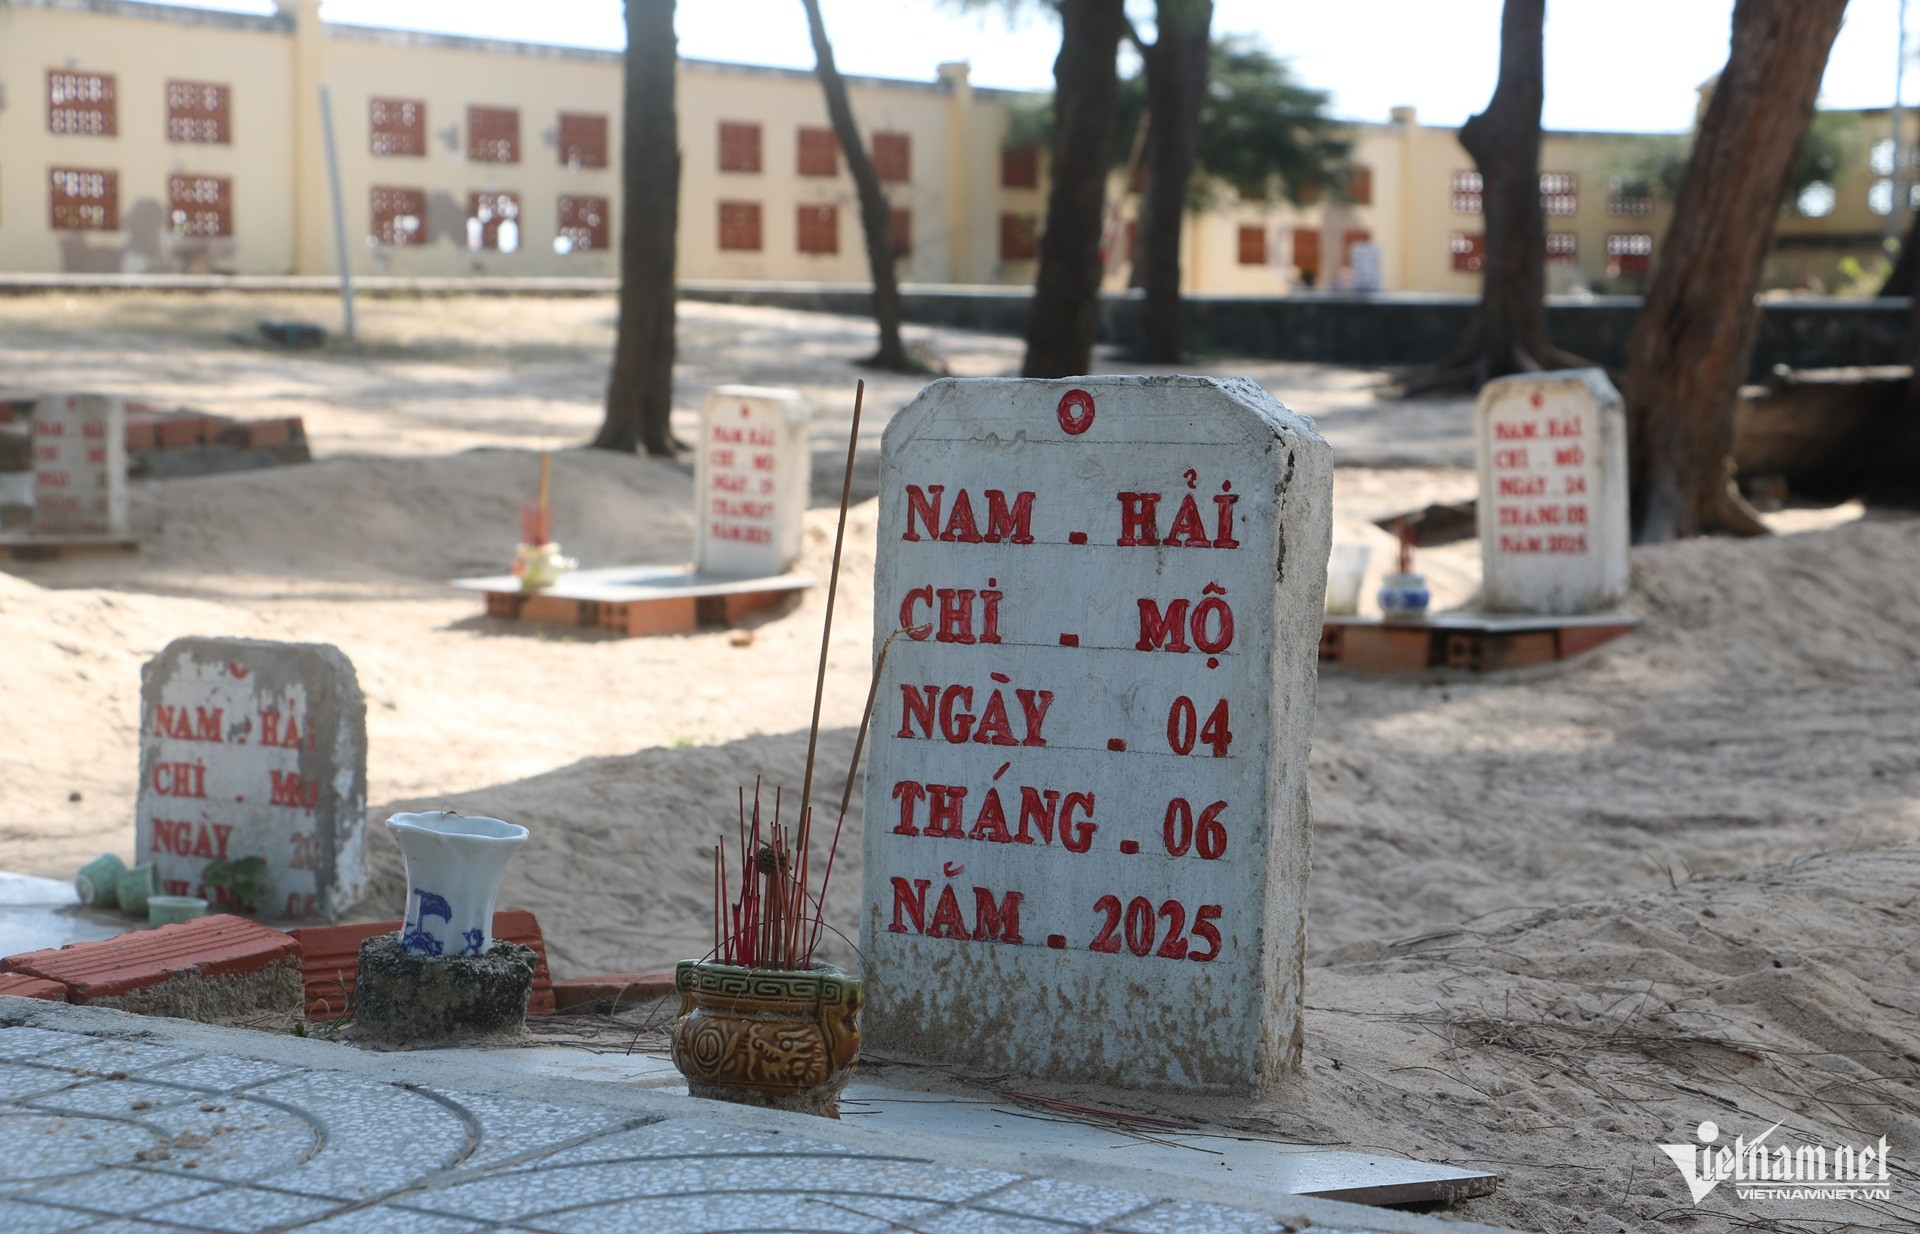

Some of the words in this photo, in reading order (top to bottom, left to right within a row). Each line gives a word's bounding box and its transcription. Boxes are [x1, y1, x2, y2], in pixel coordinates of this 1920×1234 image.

[902, 484, 1036, 545] NAM
[1116, 468, 1241, 549] HẢI
[1135, 581, 1235, 670] MỘ
[153, 703, 223, 744] NAM
[898, 672, 1054, 747] NGÀY
[1166, 695, 1233, 758] 04
[151, 812, 233, 860] NGÀY
[892, 761, 1099, 854] THÁNG
[1163, 797, 1228, 860] 06
[889, 861, 1025, 945] NĂM
[1089, 894, 1223, 962] 2025
